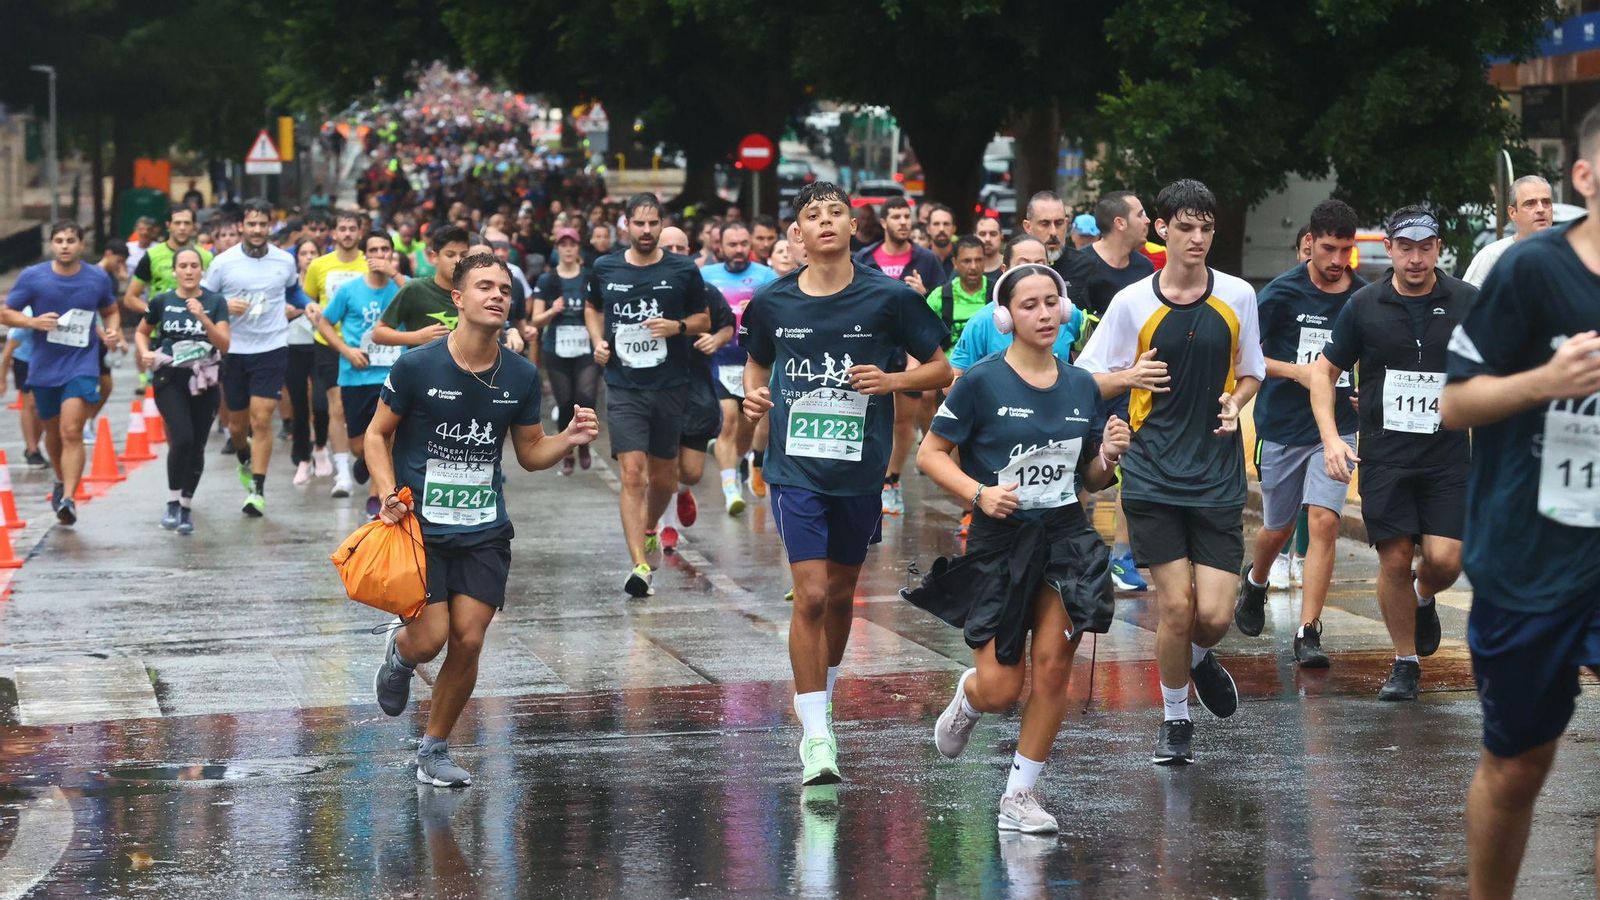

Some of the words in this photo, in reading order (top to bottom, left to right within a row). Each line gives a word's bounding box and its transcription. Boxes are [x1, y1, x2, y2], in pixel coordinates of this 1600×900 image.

[624, 339, 658, 354] 7002
[785, 357, 814, 382] 44
[438, 393, 456, 401] Unicaja
[1395, 395, 1440, 413] 1114
[435, 422, 461, 441] 44
[794, 418, 859, 440] 21223
[427, 446, 463, 461] URBANA
[428, 440, 464, 455] CARRERA
[1015, 464, 1066, 486] 1295
[429, 488, 492, 508] 21247
